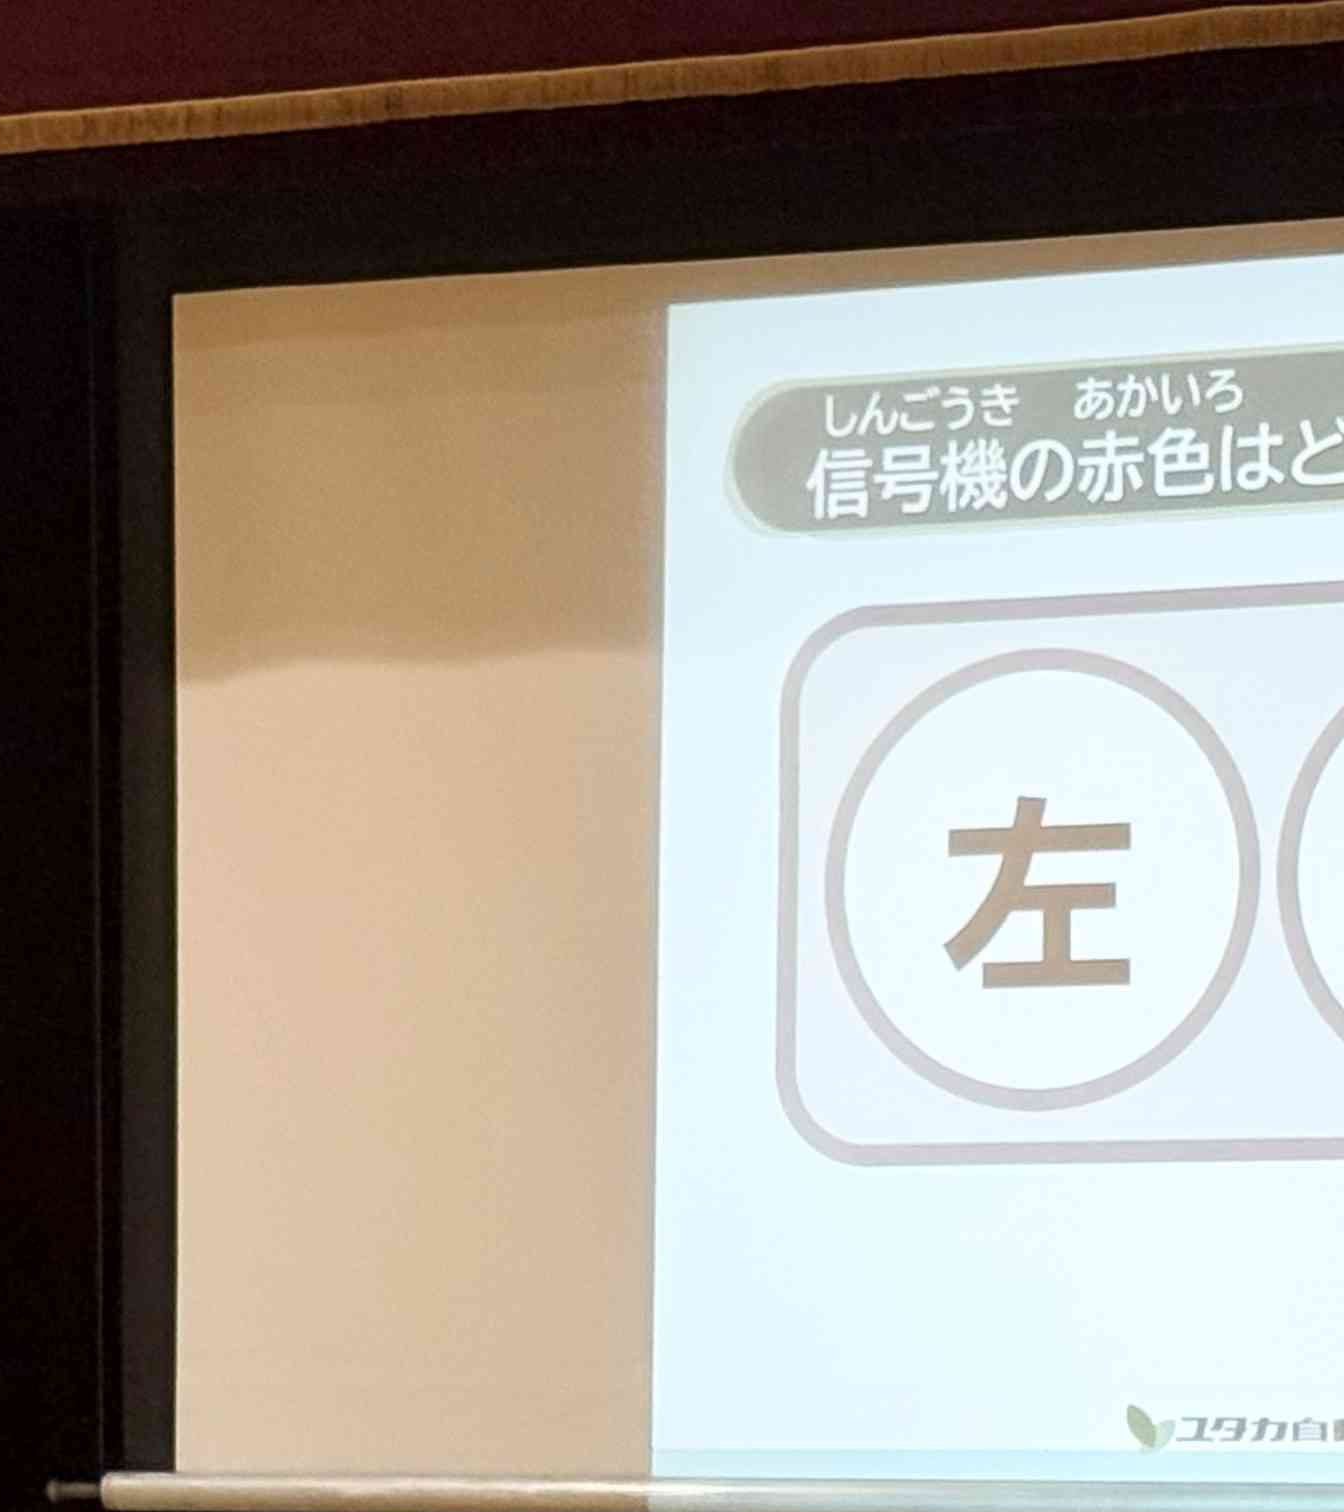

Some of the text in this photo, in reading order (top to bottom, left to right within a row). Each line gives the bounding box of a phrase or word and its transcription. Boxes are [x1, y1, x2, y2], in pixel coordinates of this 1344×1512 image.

[826, 369, 1243, 437] しんごうき あかいろ
[942, 795, 1132, 988] 左
